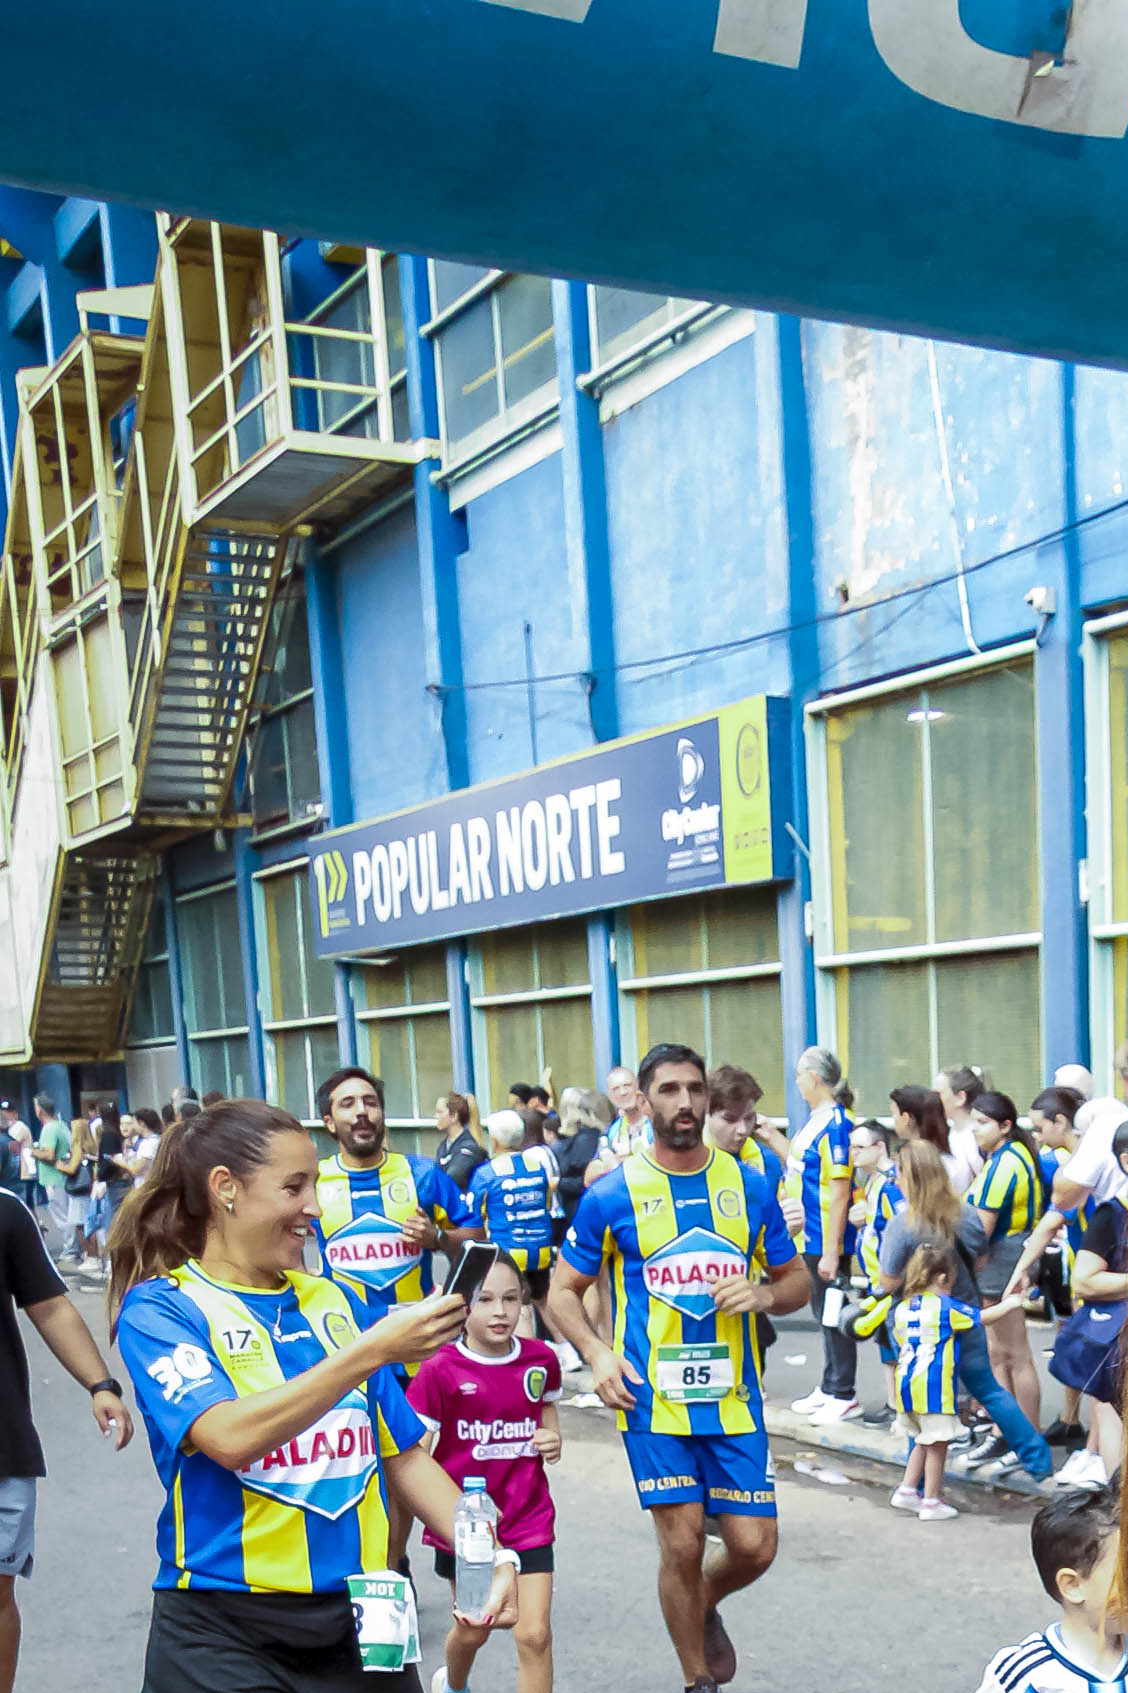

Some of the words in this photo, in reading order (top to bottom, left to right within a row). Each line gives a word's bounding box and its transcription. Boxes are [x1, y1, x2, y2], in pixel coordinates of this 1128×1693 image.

[353, 830, 494, 926] POPULAR
[496, 778, 625, 897] NORTE
[222, 1329, 253, 1350] 17
[147, 1342, 213, 1402] 30
[682, 1366, 711, 1385] 85
[365, 1581, 396, 1597] 10K
